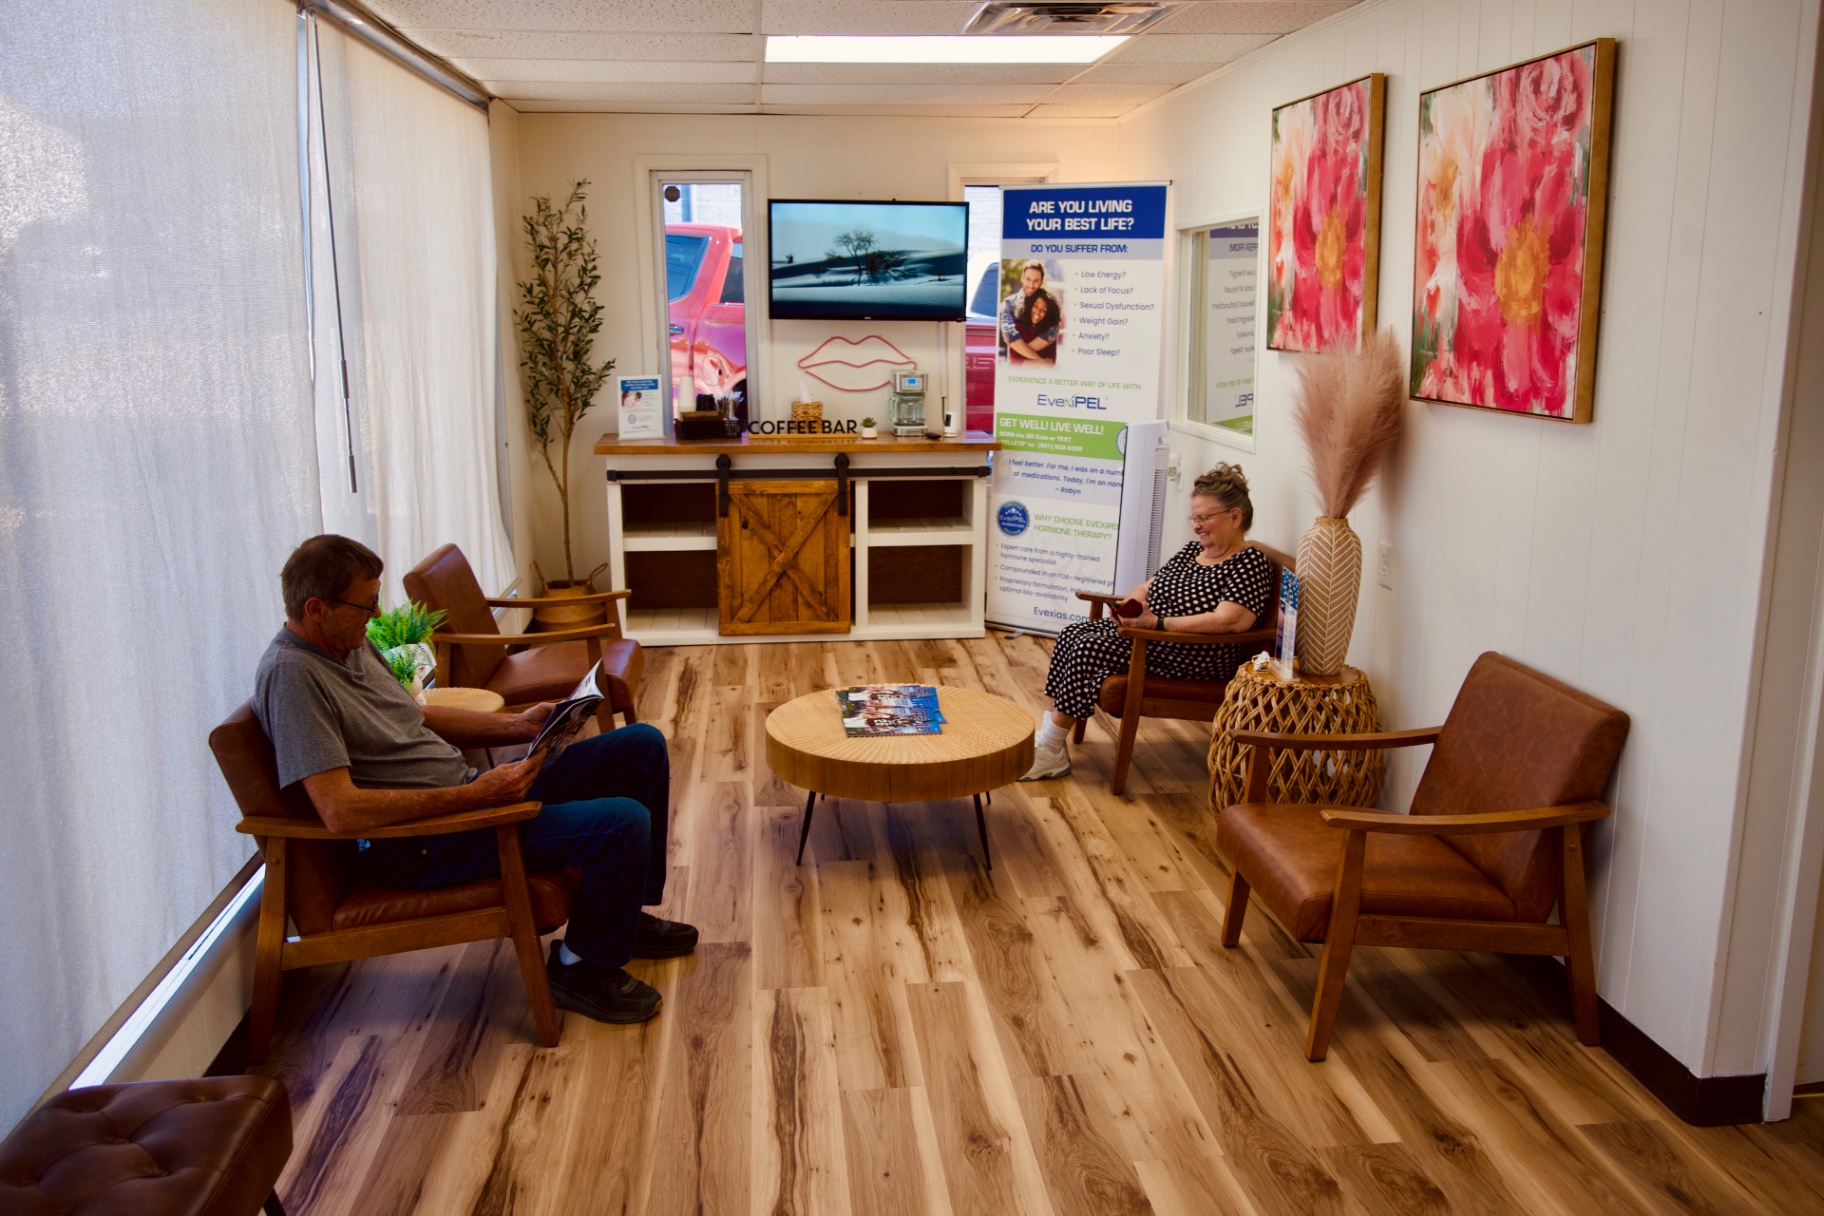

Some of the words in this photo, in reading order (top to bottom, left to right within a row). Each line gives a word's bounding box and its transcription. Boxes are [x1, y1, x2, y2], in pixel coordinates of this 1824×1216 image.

[1029, 201, 1055, 214] ARE
[1058, 200, 1085, 213] YOU
[1088, 199, 1133, 213] LIVING
[1026, 218, 1062, 231] YOUR
[1064, 217, 1098, 230] BEST
[1100, 217, 1135, 230] LIFE?
[1030, 244, 1043, 253] DO
[1045, 244, 1063, 253] YOU
[1065, 244, 1098, 253] SUFFER
[1100, 244, 1129, 253] FROM:
[1097, 271, 1126, 280] Energy?
[1080, 286, 1097, 294] Lack
[1106, 302, 1154, 311] Dysfunction?
[1079, 317, 1105, 326] Weight
[1078, 332, 1109, 342] Anxiety?
[1096, 348, 1120, 358] Sleep?
[1008, 375, 1047, 384] EXPERIENCE
[1054, 378, 1079, 387] BETTER
[1037, 393, 1107, 411] EvexiPEL
[748, 420, 818, 435] COFFEE
[821, 420, 857, 434] BAR
[1000, 417, 1018, 428] GET
[1019, 418, 1049, 430] WELL!
[1050, 421, 1071, 432] LIVE
[1073, 423, 1104, 435] WELL!
[1063, 475, 1085, 485] Today,
[1060, 486, 1081, 495] Robyn
[1034, 513, 1052, 522] WHY
[1053, 515, 1084, 526] CHOOSE
[1033, 524, 1072, 536] HORMONE
[1073, 529, 1112, 541] THERAPY?
[1000, 552, 1028, 561] hormone
[1028, 556, 1057, 566] specialist
[1055, 550, 1100, 562] highly-trained
[1000, 563, 1041, 576] Compounded
[1074, 576, 1106, 584] registered
[1000, 575, 1032, 587] Proprietary
